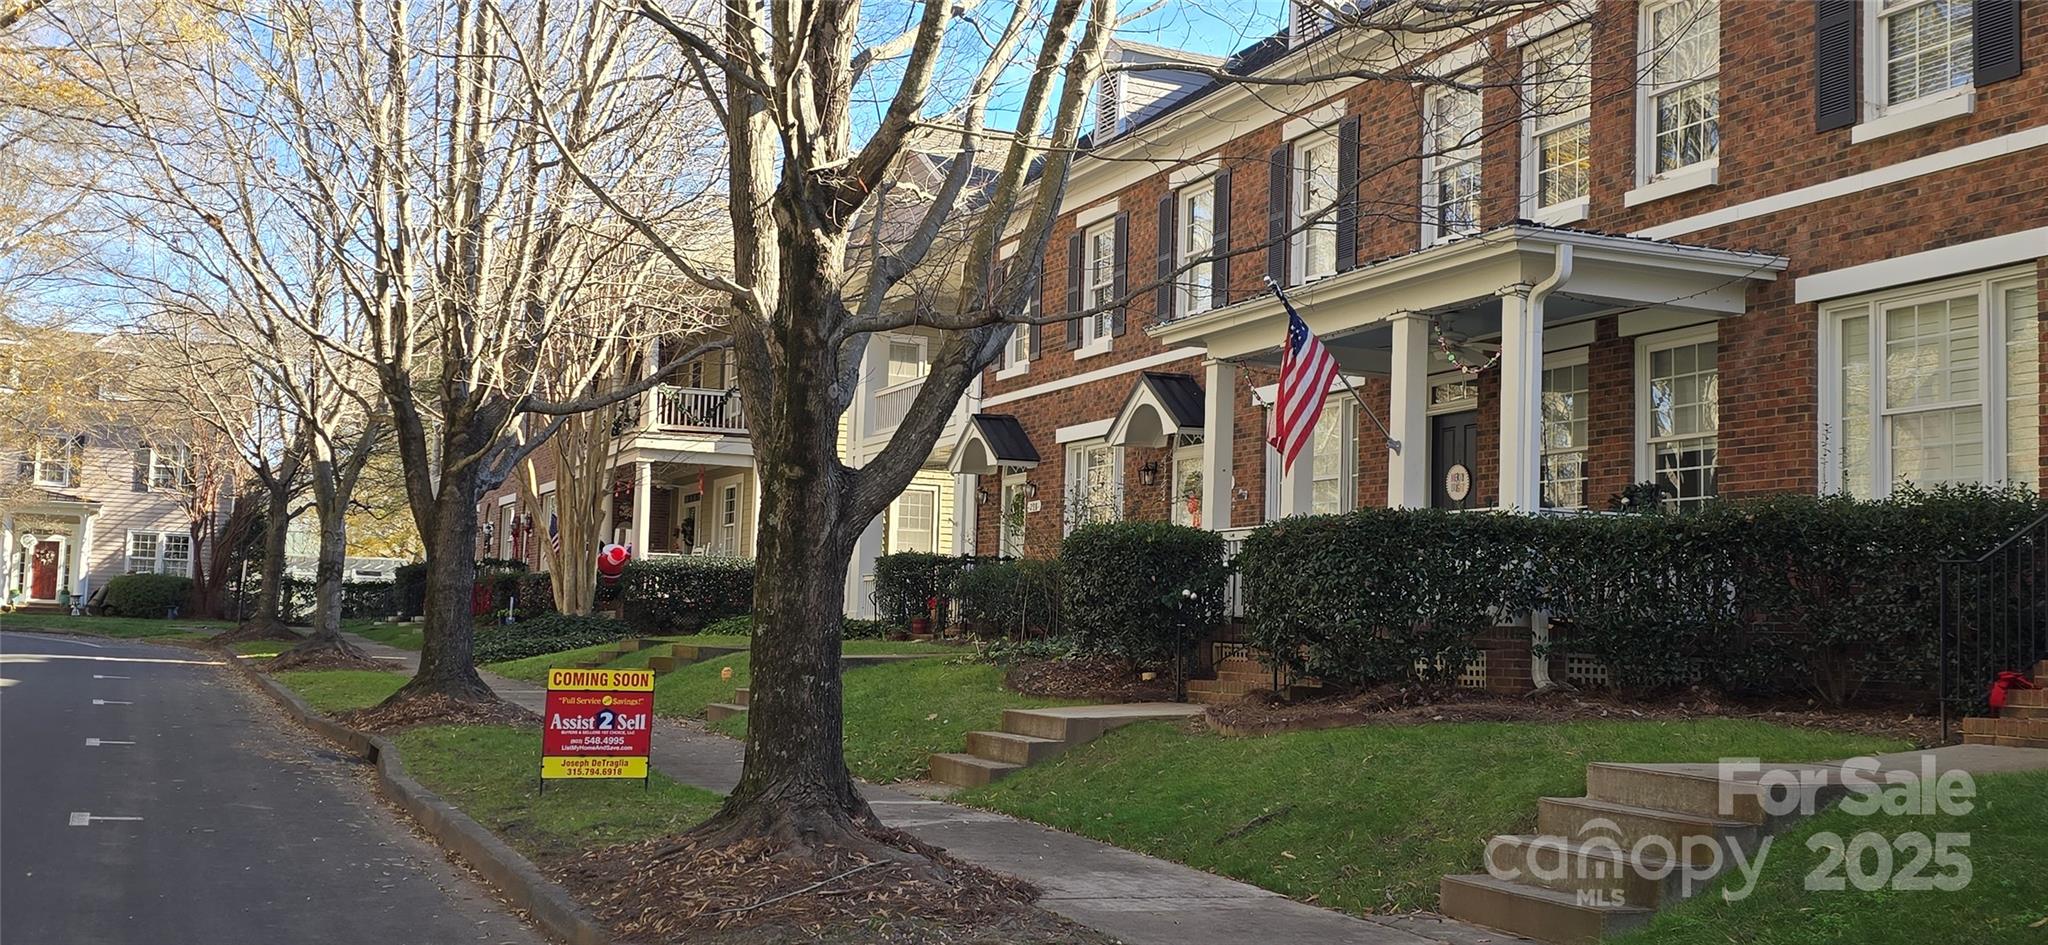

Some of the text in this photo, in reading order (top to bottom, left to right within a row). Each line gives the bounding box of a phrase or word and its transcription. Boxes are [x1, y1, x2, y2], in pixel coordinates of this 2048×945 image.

[553, 672, 649, 687] COMING SOON
[576, 697, 601, 705] Service
[550, 711, 646, 730] Assist 2 Sell
[584, 737, 625, 745] 548.4995
[561, 760, 629, 768] Joseph DeTraglia
